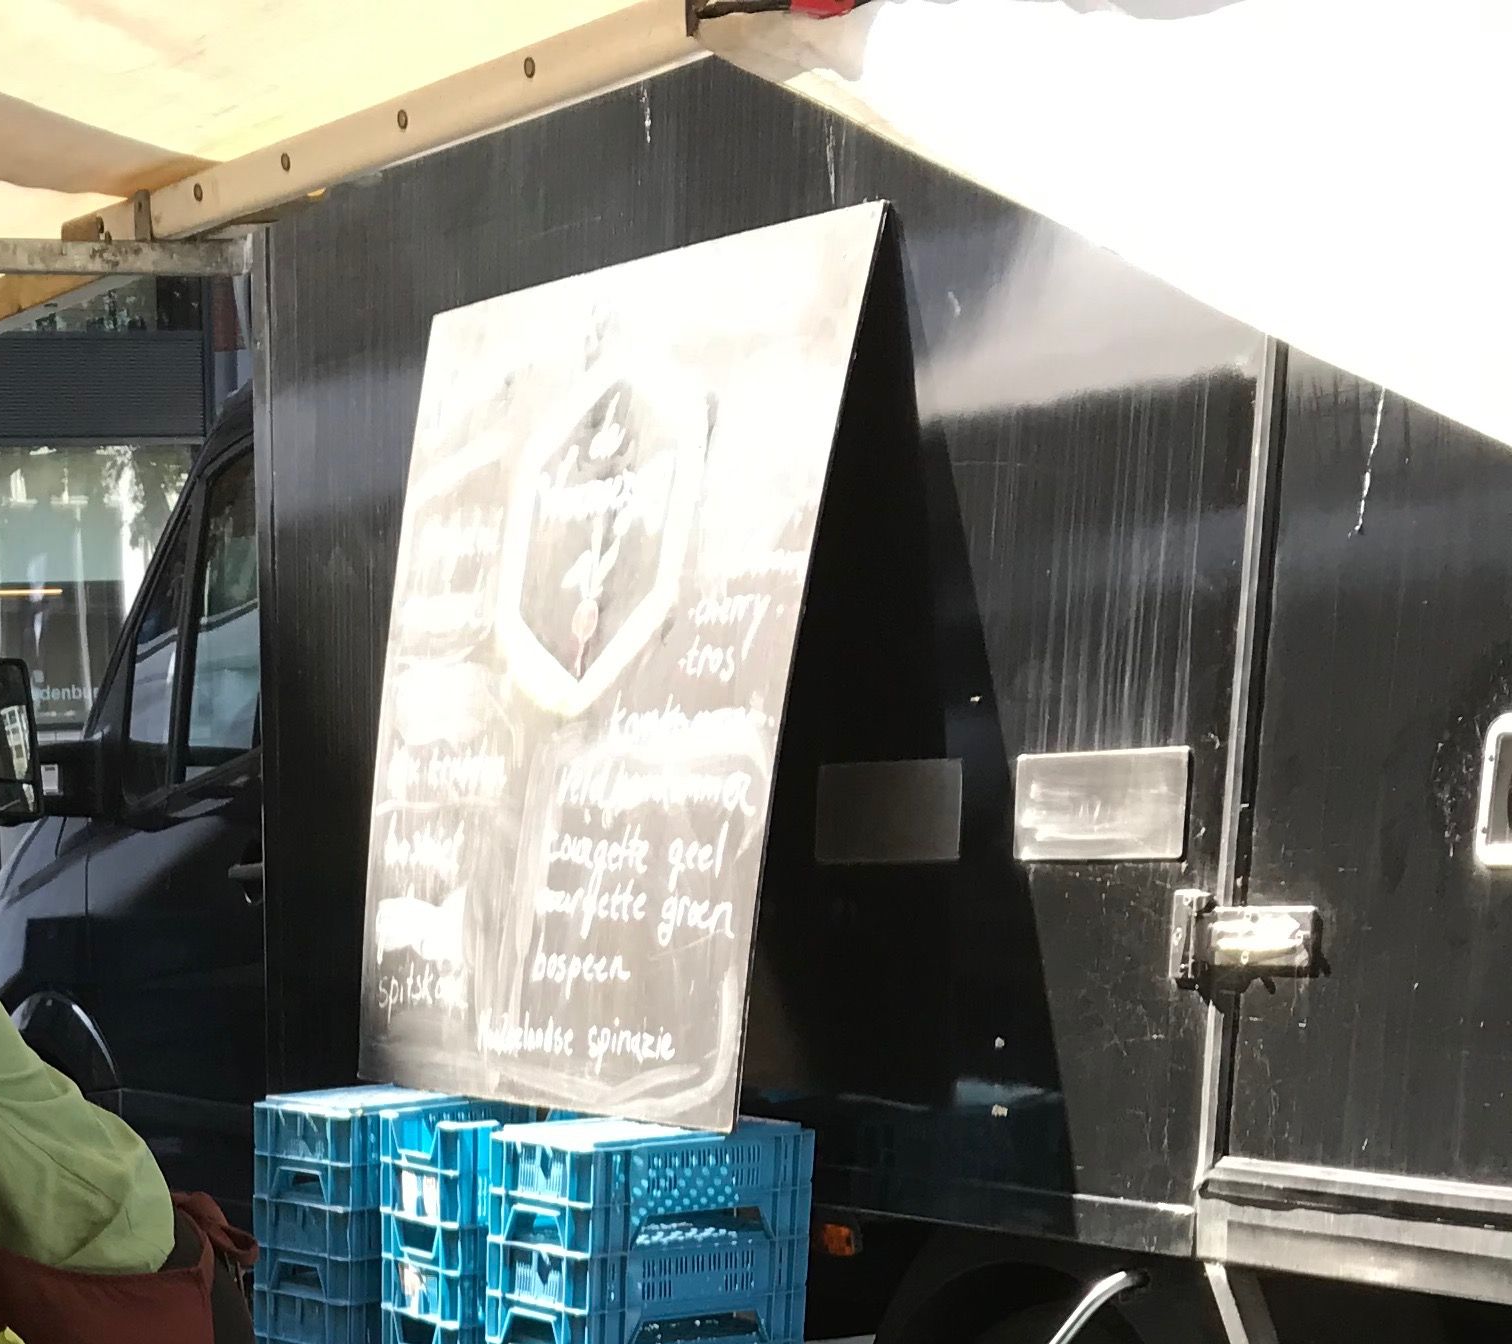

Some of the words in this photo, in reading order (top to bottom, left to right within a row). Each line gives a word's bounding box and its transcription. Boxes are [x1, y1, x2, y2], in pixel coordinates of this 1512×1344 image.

[668, 821, 728, 893] geel
[531, 932, 630, 999] bospeen
[588, 1017, 675, 1075] spinazie
